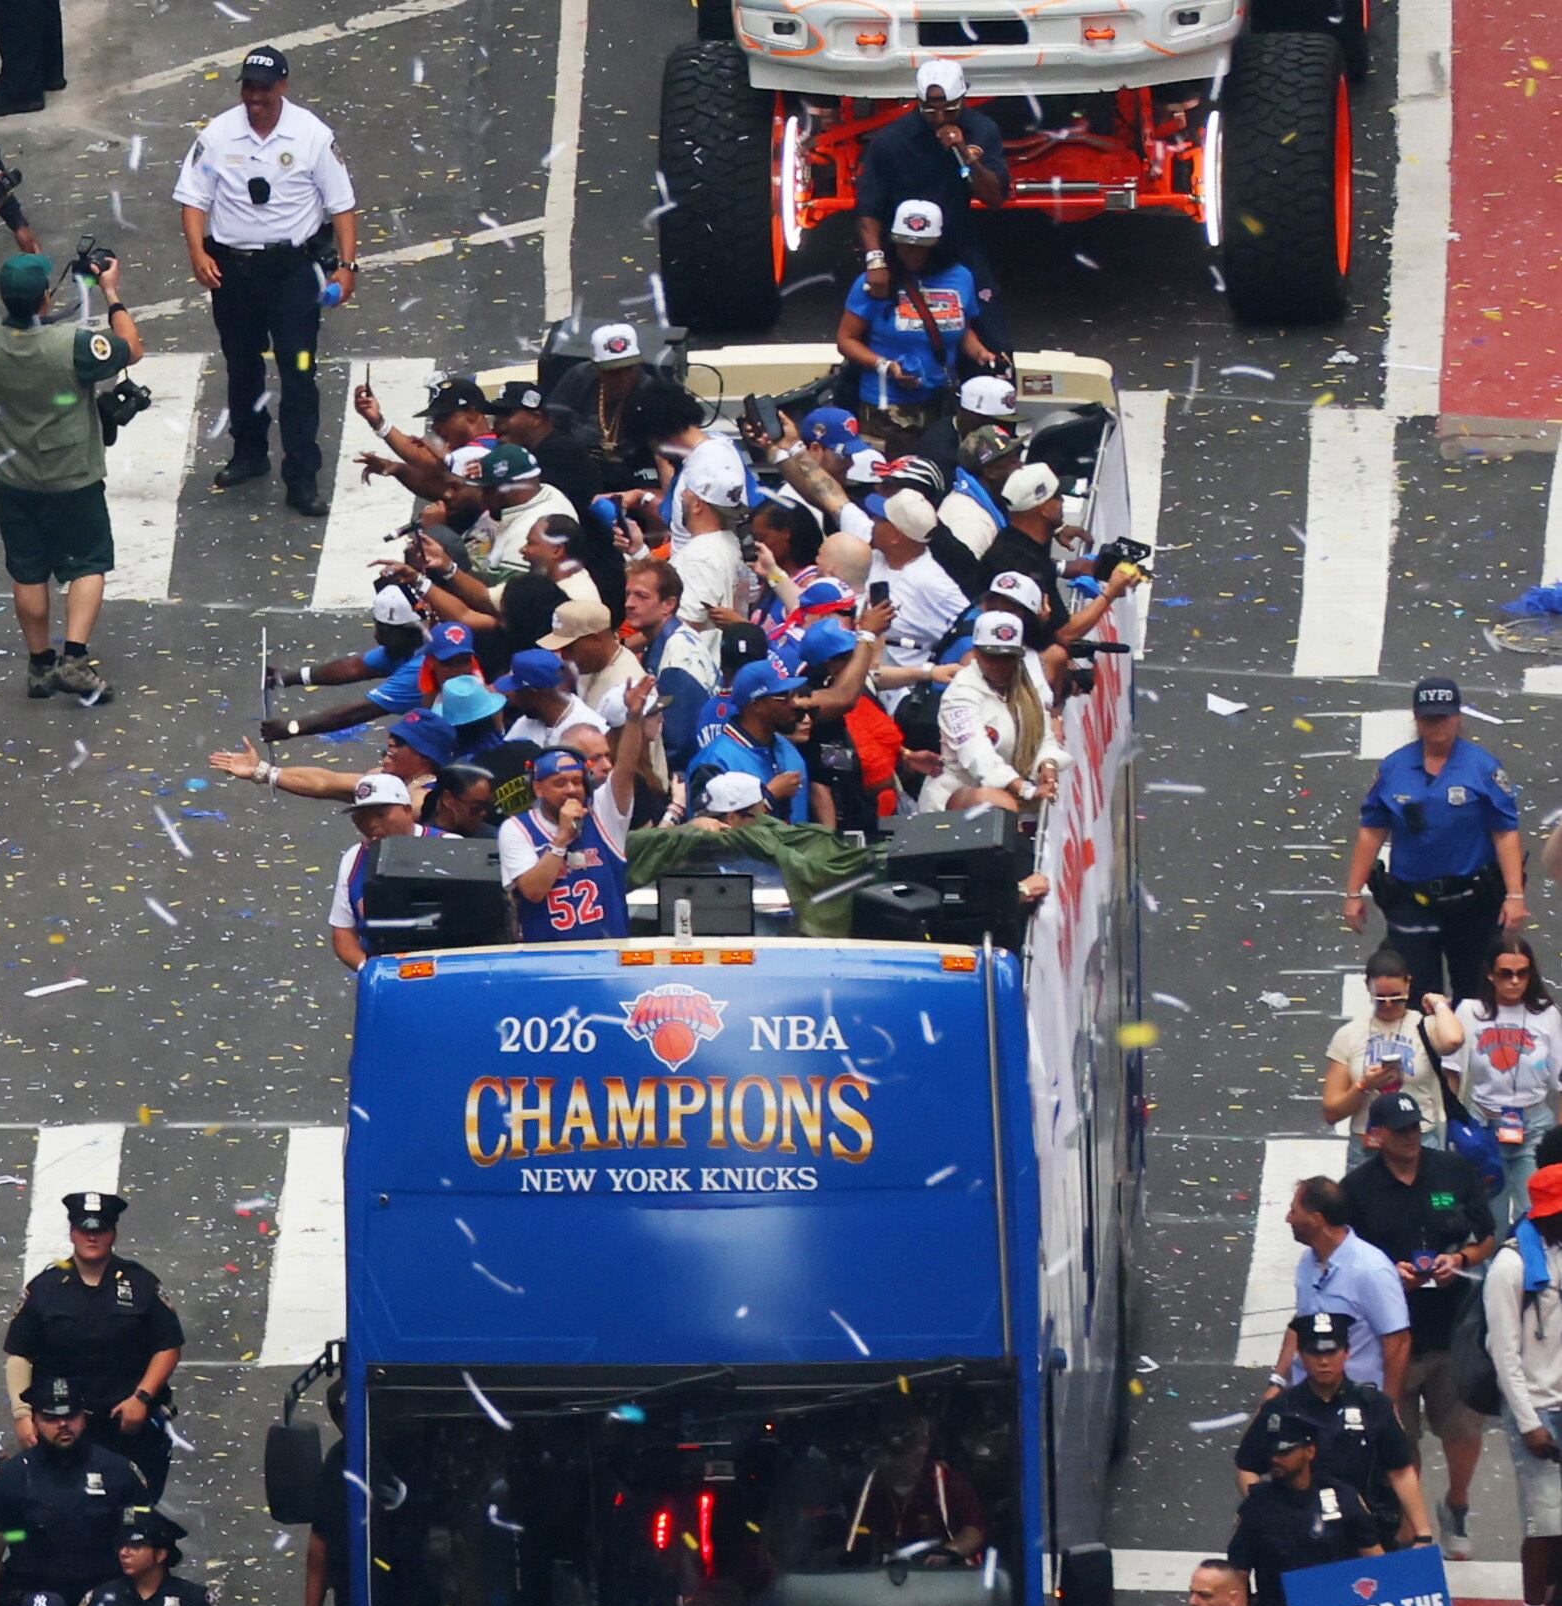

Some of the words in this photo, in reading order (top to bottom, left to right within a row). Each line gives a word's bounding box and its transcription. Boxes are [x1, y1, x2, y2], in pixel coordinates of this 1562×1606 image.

[246, 54, 275, 69] NYPD
[1418, 689, 1454, 703] NYPD
[547, 879, 604, 931] 52
[499, 1018, 598, 1053] 2026
[748, 1018, 849, 1051] NBA
[464, 1074, 874, 1167] CHAMPIONS
[520, 1168, 599, 1193] NEW
[605, 1168, 692, 1193] YORK
[698, 1168, 818, 1193] KNICKS
